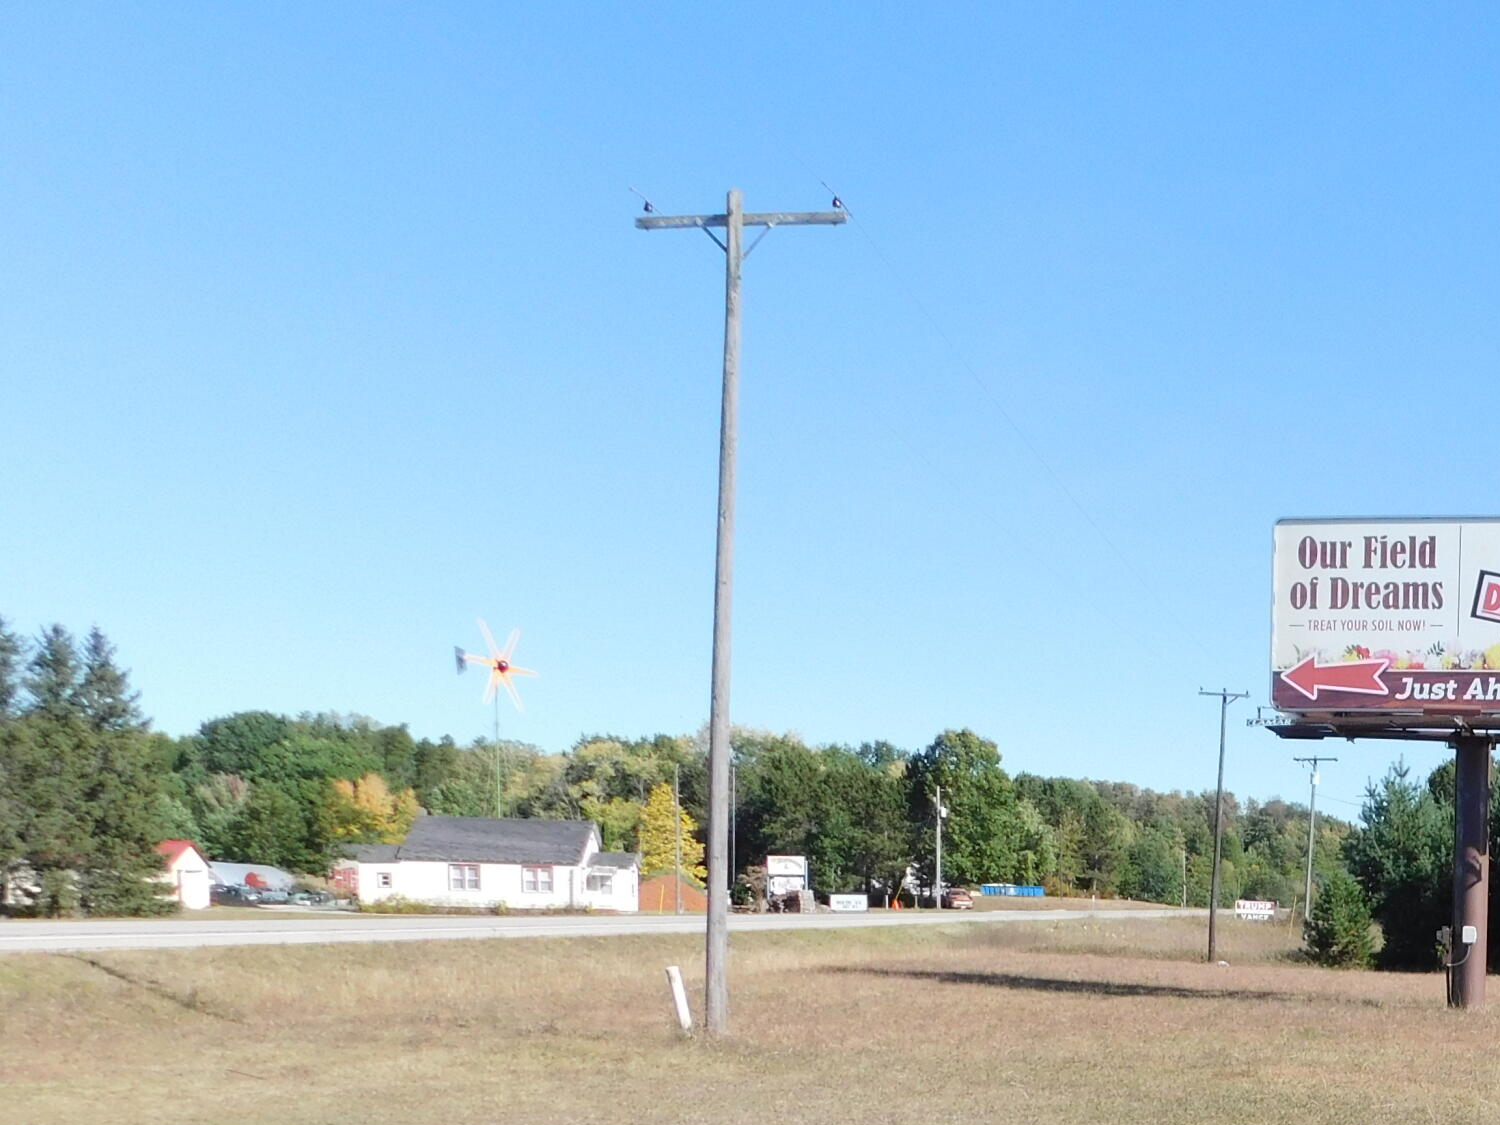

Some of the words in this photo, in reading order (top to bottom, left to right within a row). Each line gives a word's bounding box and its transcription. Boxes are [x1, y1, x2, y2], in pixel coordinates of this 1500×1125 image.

[1298, 535, 1352, 569] Our
[1362, 535, 1437, 569] Field
[1290, 577, 1319, 610] of
[1329, 577, 1444, 610] Dreams
[1308, 619, 1338, 631] TREAT
[1341, 619, 1368, 631] YOUR
[1372, 619, 1394, 631] SOIL
[1398, 619, 1426, 631] NOW!
[1395, 677, 1458, 700] Just
